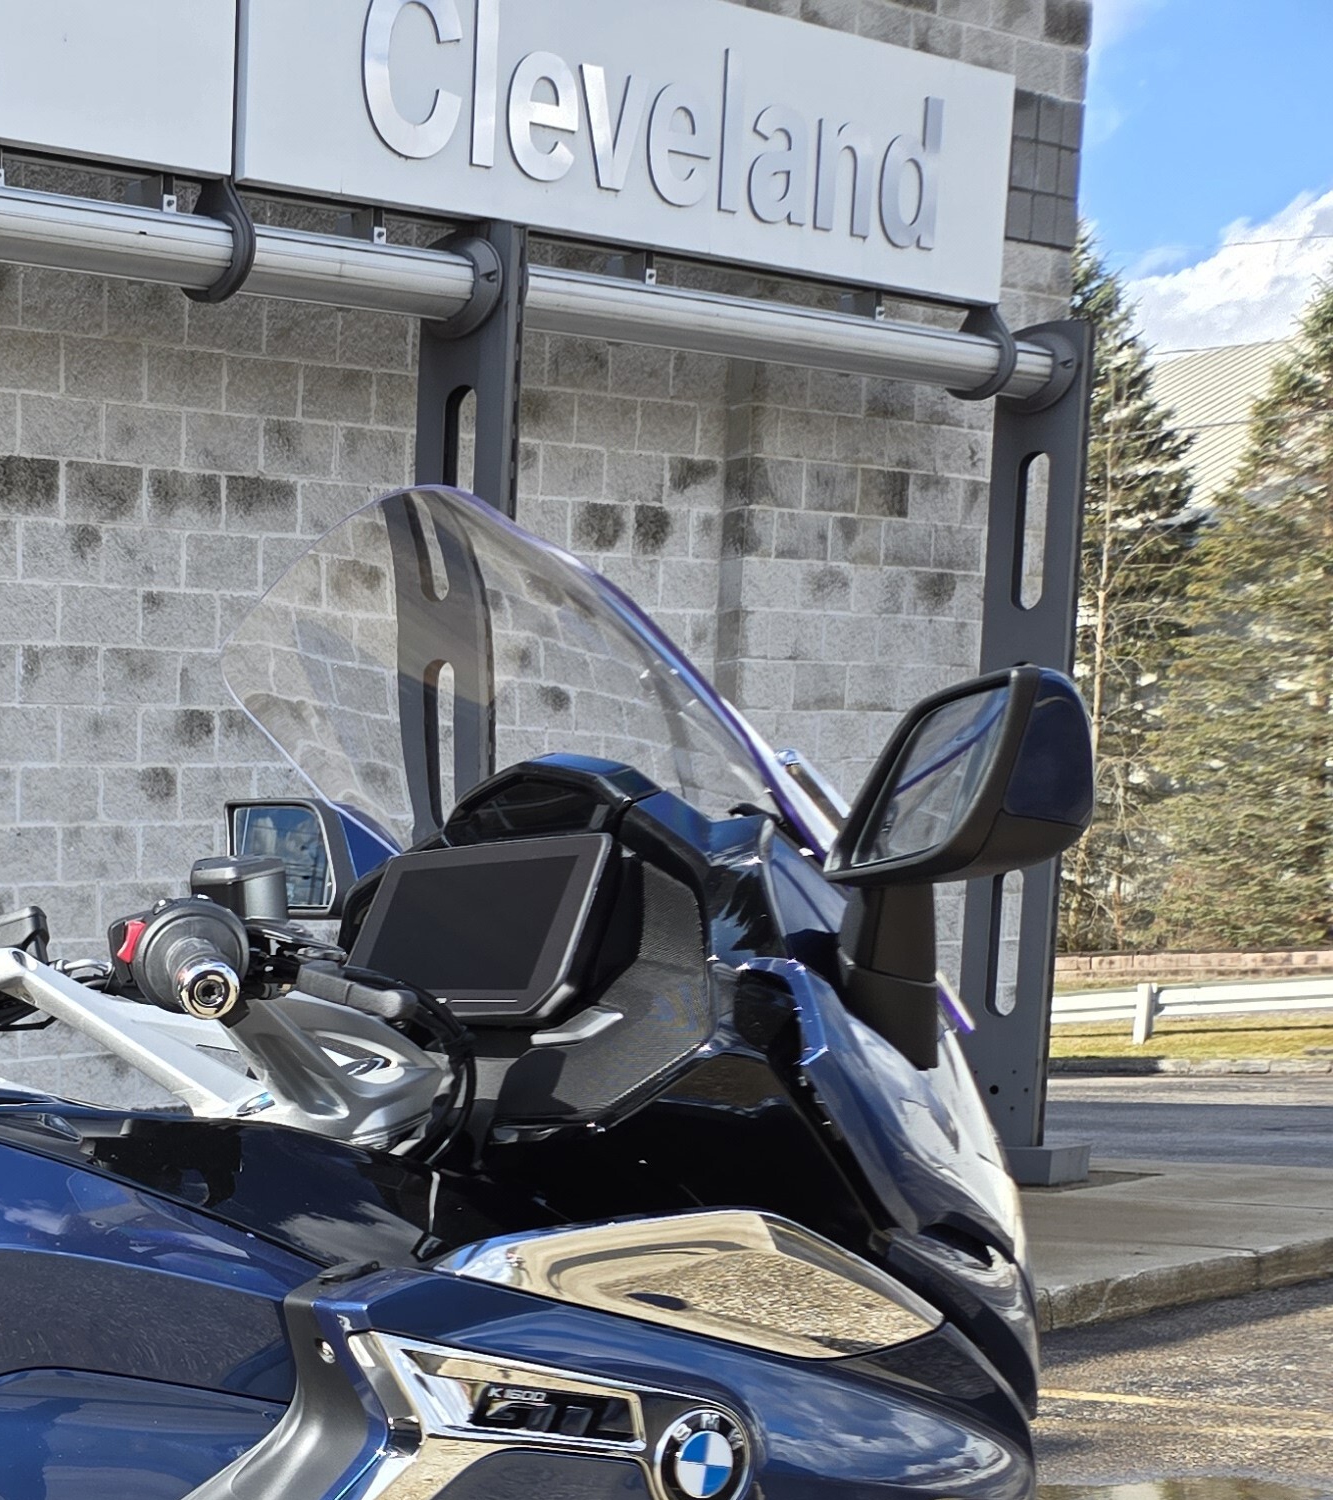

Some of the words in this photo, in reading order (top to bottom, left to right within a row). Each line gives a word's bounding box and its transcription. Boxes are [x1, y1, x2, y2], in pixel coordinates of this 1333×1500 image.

[361, 0, 945, 251] Cleveland
[487, 1387, 503, 1398] K
[504, 1388, 548, 1402] 1600
[669, 1412, 745, 1451] BMW
